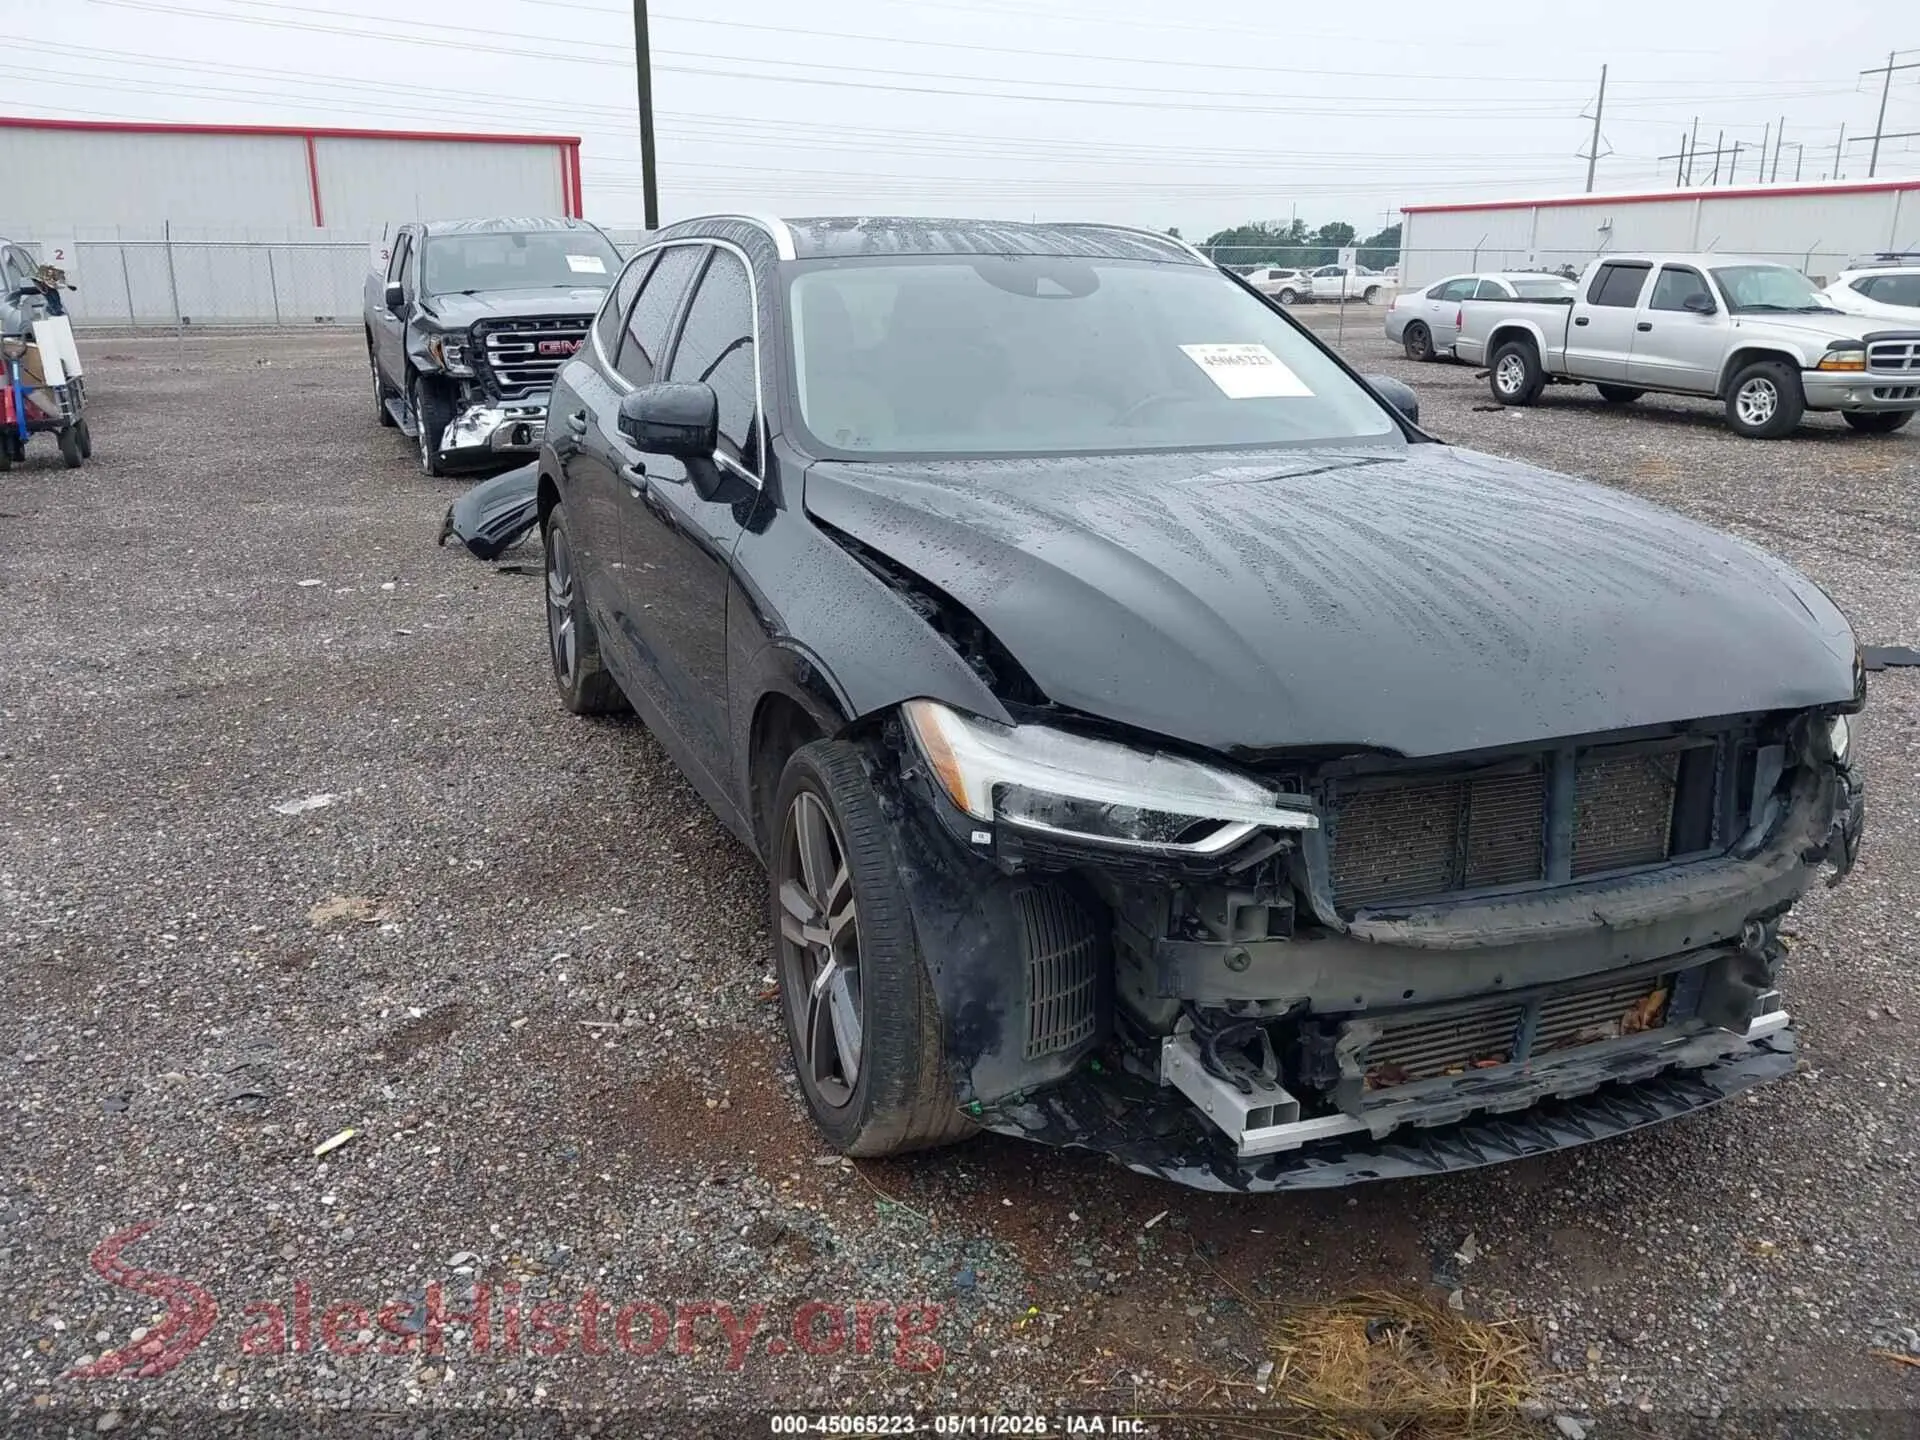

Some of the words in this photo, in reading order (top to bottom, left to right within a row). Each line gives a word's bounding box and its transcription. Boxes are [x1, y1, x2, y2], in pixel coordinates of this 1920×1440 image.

[55, 249, 65, 260] 2
[380, 249, 389, 260] 3
[538, 340, 585, 355] GM
